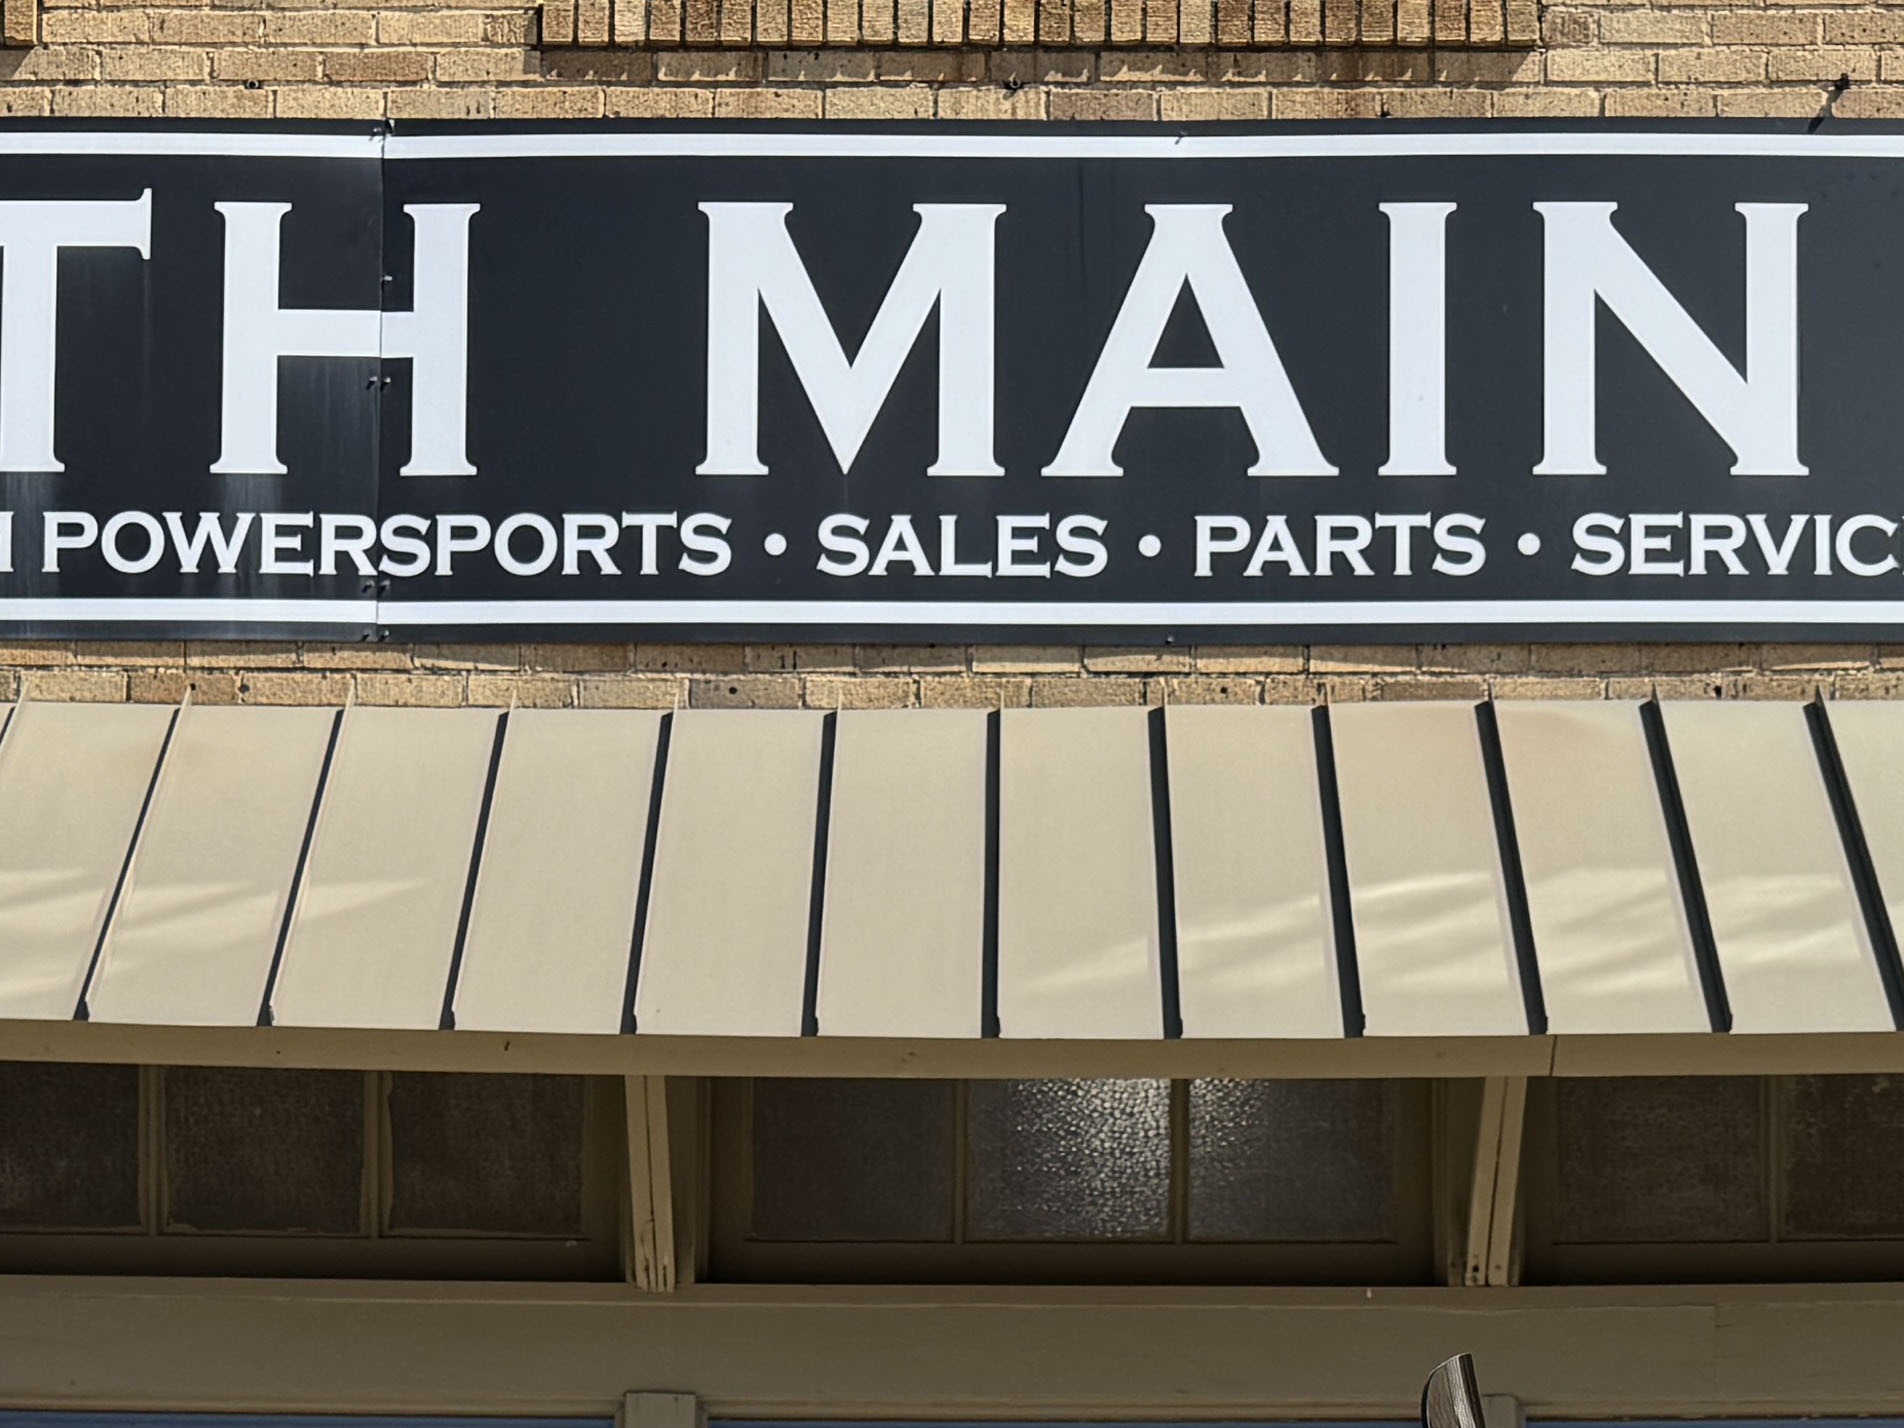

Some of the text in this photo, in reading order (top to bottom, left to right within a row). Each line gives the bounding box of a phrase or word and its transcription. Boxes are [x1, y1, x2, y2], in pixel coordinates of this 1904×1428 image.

[695, 201, 1810, 477] MAIN
[41, 510, 732, 577] POWERSPORTS
[816, 512, 1108, 579] SALES
[1194, 511, 1486, 578] PARTS
